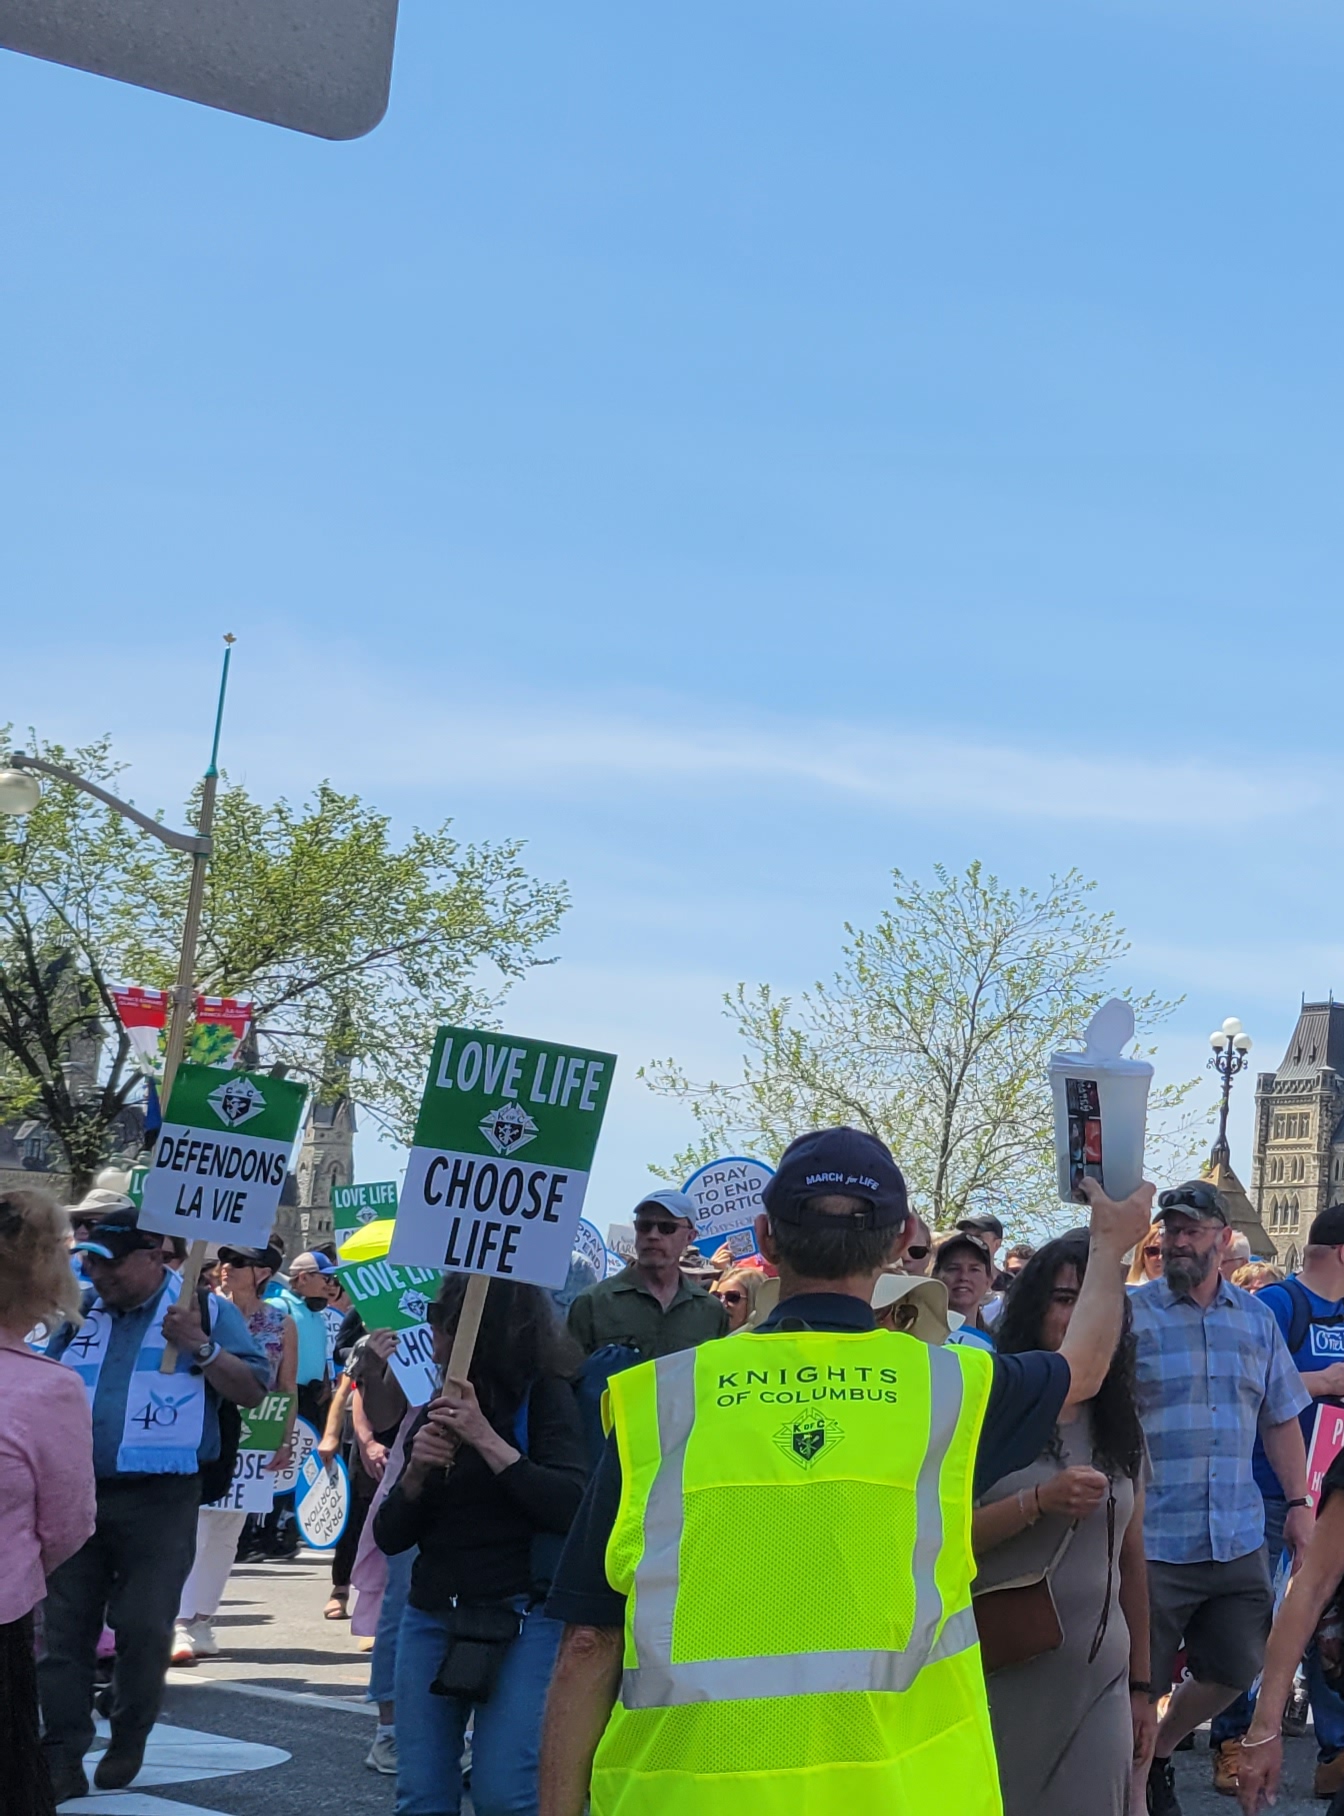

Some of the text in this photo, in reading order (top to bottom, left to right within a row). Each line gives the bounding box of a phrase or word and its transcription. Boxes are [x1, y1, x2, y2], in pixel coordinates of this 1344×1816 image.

[435, 1037, 605, 1111] LOVE LIFE
[156, 1129, 287, 1186] DÉFENDONS
[423, 1155, 569, 1223] CHOOSE
[702, 1165, 749, 1188] PRAY
[806, 1172, 880, 1191] MARCH for LIFE
[175, 1183, 203, 1219] LA
[211, 1188, 248, 1224] VIE
[334, 1184, 396, 1209] LOVE LIFE
[694, 1178, 762, 1205] TO END
[696, 1193, 763, 1221] BORTIO
[444, 1217, 522, 1274] LIFE
[343, 1260, 407, 1302] LOVE
[718, 1365, 898, 1389] KNIGHTS
[716, 1386, 898, 1408] OF COLUMBUS
[130, 1401, 178, 1430] 40
[793, 1423, 802, 1433] K
[816, 1419, 825, 1429] C
[314, 1491, 343, 1534] TO END
[323, 1507, 344, 1541] PRAY
